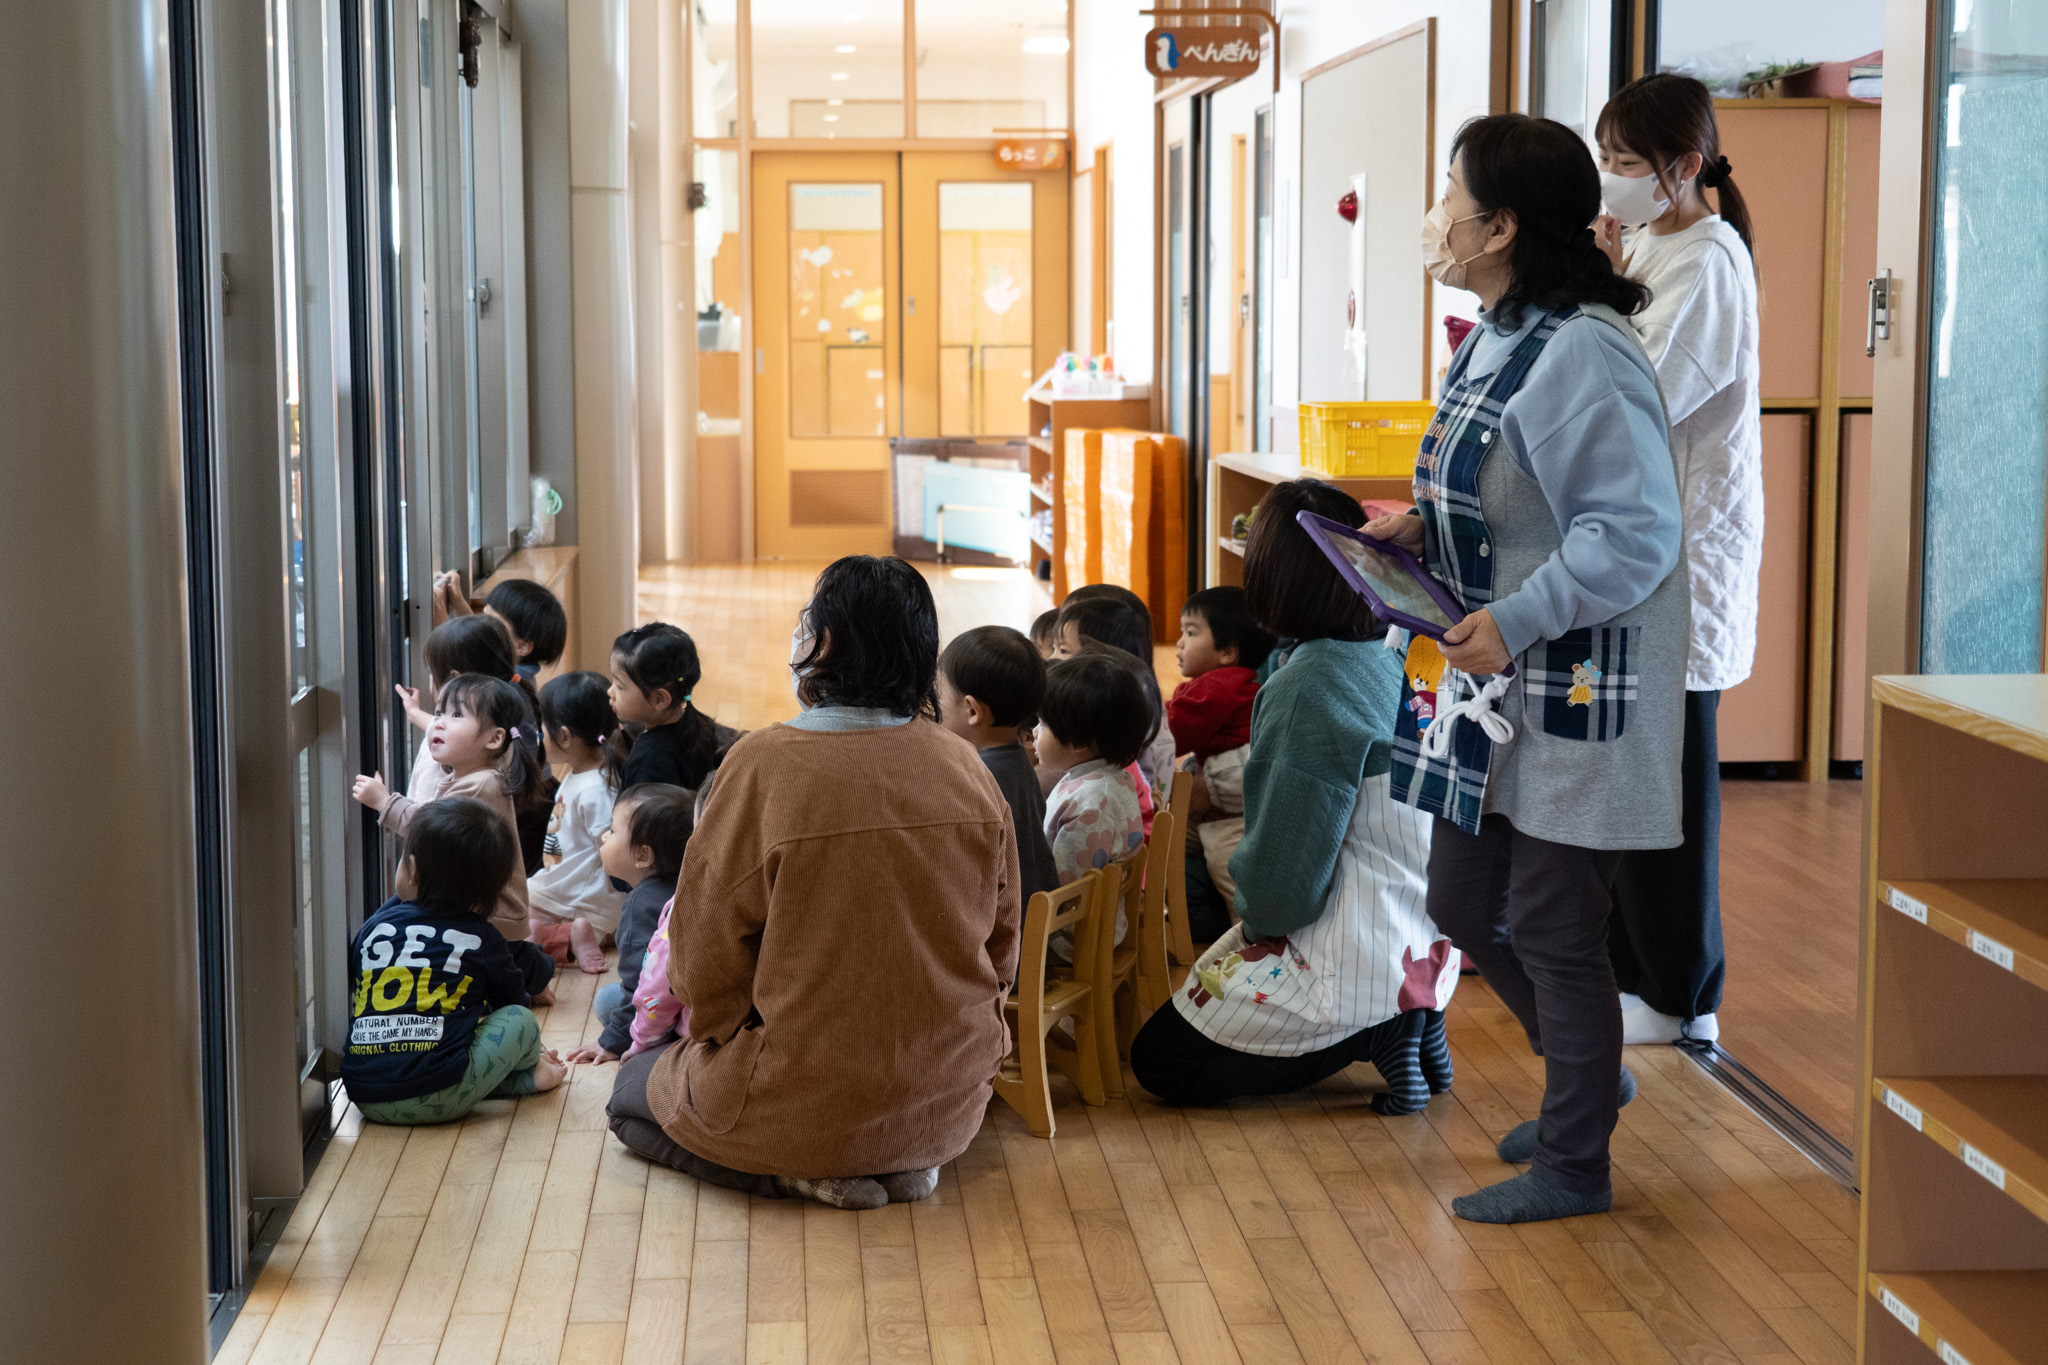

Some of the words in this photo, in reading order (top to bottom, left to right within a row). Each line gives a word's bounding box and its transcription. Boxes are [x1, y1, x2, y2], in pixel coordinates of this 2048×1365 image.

[360, 922, 482, 974] GET
[354, 1017, 391, 1030] NATURAL
[396, 1016, 439, 1027] NUMBER
[352, 1031, 366, 1042] HAVE
[368, 1030, 381, 1042] THE
[382, 1028, 399, 1040] GAME
[401, 1027, 413, 1037] MY
[414, 1027, 438, 1037] HANDS
